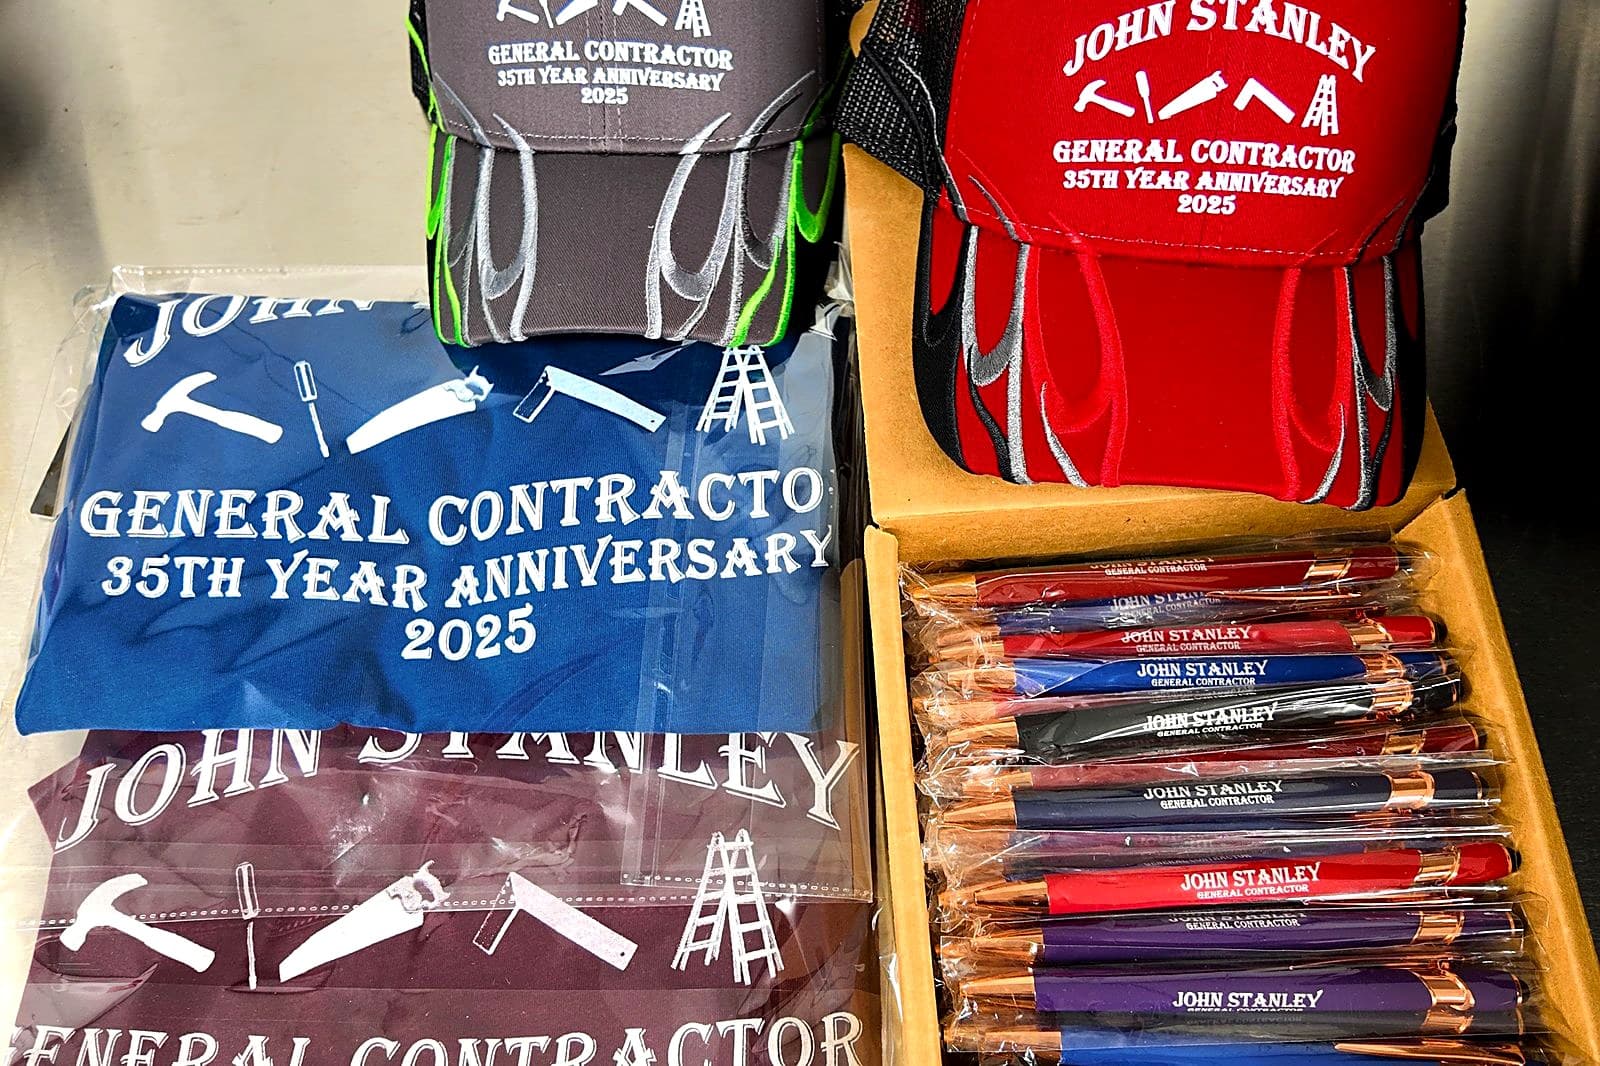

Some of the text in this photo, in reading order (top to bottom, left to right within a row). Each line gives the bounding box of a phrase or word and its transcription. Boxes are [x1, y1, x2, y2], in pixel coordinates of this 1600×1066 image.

[1062, 0, 1377, 83] JOHN STANLEY
[488, 40, 734, 71] GENERAL CONTRACTOR
[497, 65, 725, 92] 35TH YEAR ANNIVERSARY
[581, 87, 629, 105] 2025
[1052, 139, 1356, 174] GENERAL CONTRACTOR
[1063, 166, 1345, 198] 35TH YEAR ANNIVERSARY
[1176, 194, 1237, 215] 2025
[80, 489, 410, 545] GENERAL
[101, 524, 833, 613] 35TH YEAR ANNIVERSARY
[1105, 566, 1147, 576] GENERAL
[1147, 563, 1208, 575] CONTRACTOR
[401, 602, 537, 661] 2025
[1121, 625, 1252, 644] JOHN STANLEY
[1136, 641, 1241, 653] GENERAL CONTRACTOR
[1137, 659, 1268, 677] JOHN STANLEY
[1151, 677, 1256, 687] GENERAL CONTRACTOR
[1143, 702, 1279, 732] JOHN STANLEY
[1157, 722, 1263, 738] GENERAL CONTRACTOR
[53, 728, 322, 855] JOHN
[1143, 780, 1283, 800] JOHN STANLEY
[1160, 794, 1275, 810] GENERAL CONTRACTOR
[1180, 861, 1321, 891] JOHN STANLEY
[1197, 883, 1309, 899] GENERAL CONTRACTOR
[1186, 918, 1300, 931] GENERAL CONTRACTOR
[1172, 989, 1324, 1008] JOHN STANLEY
